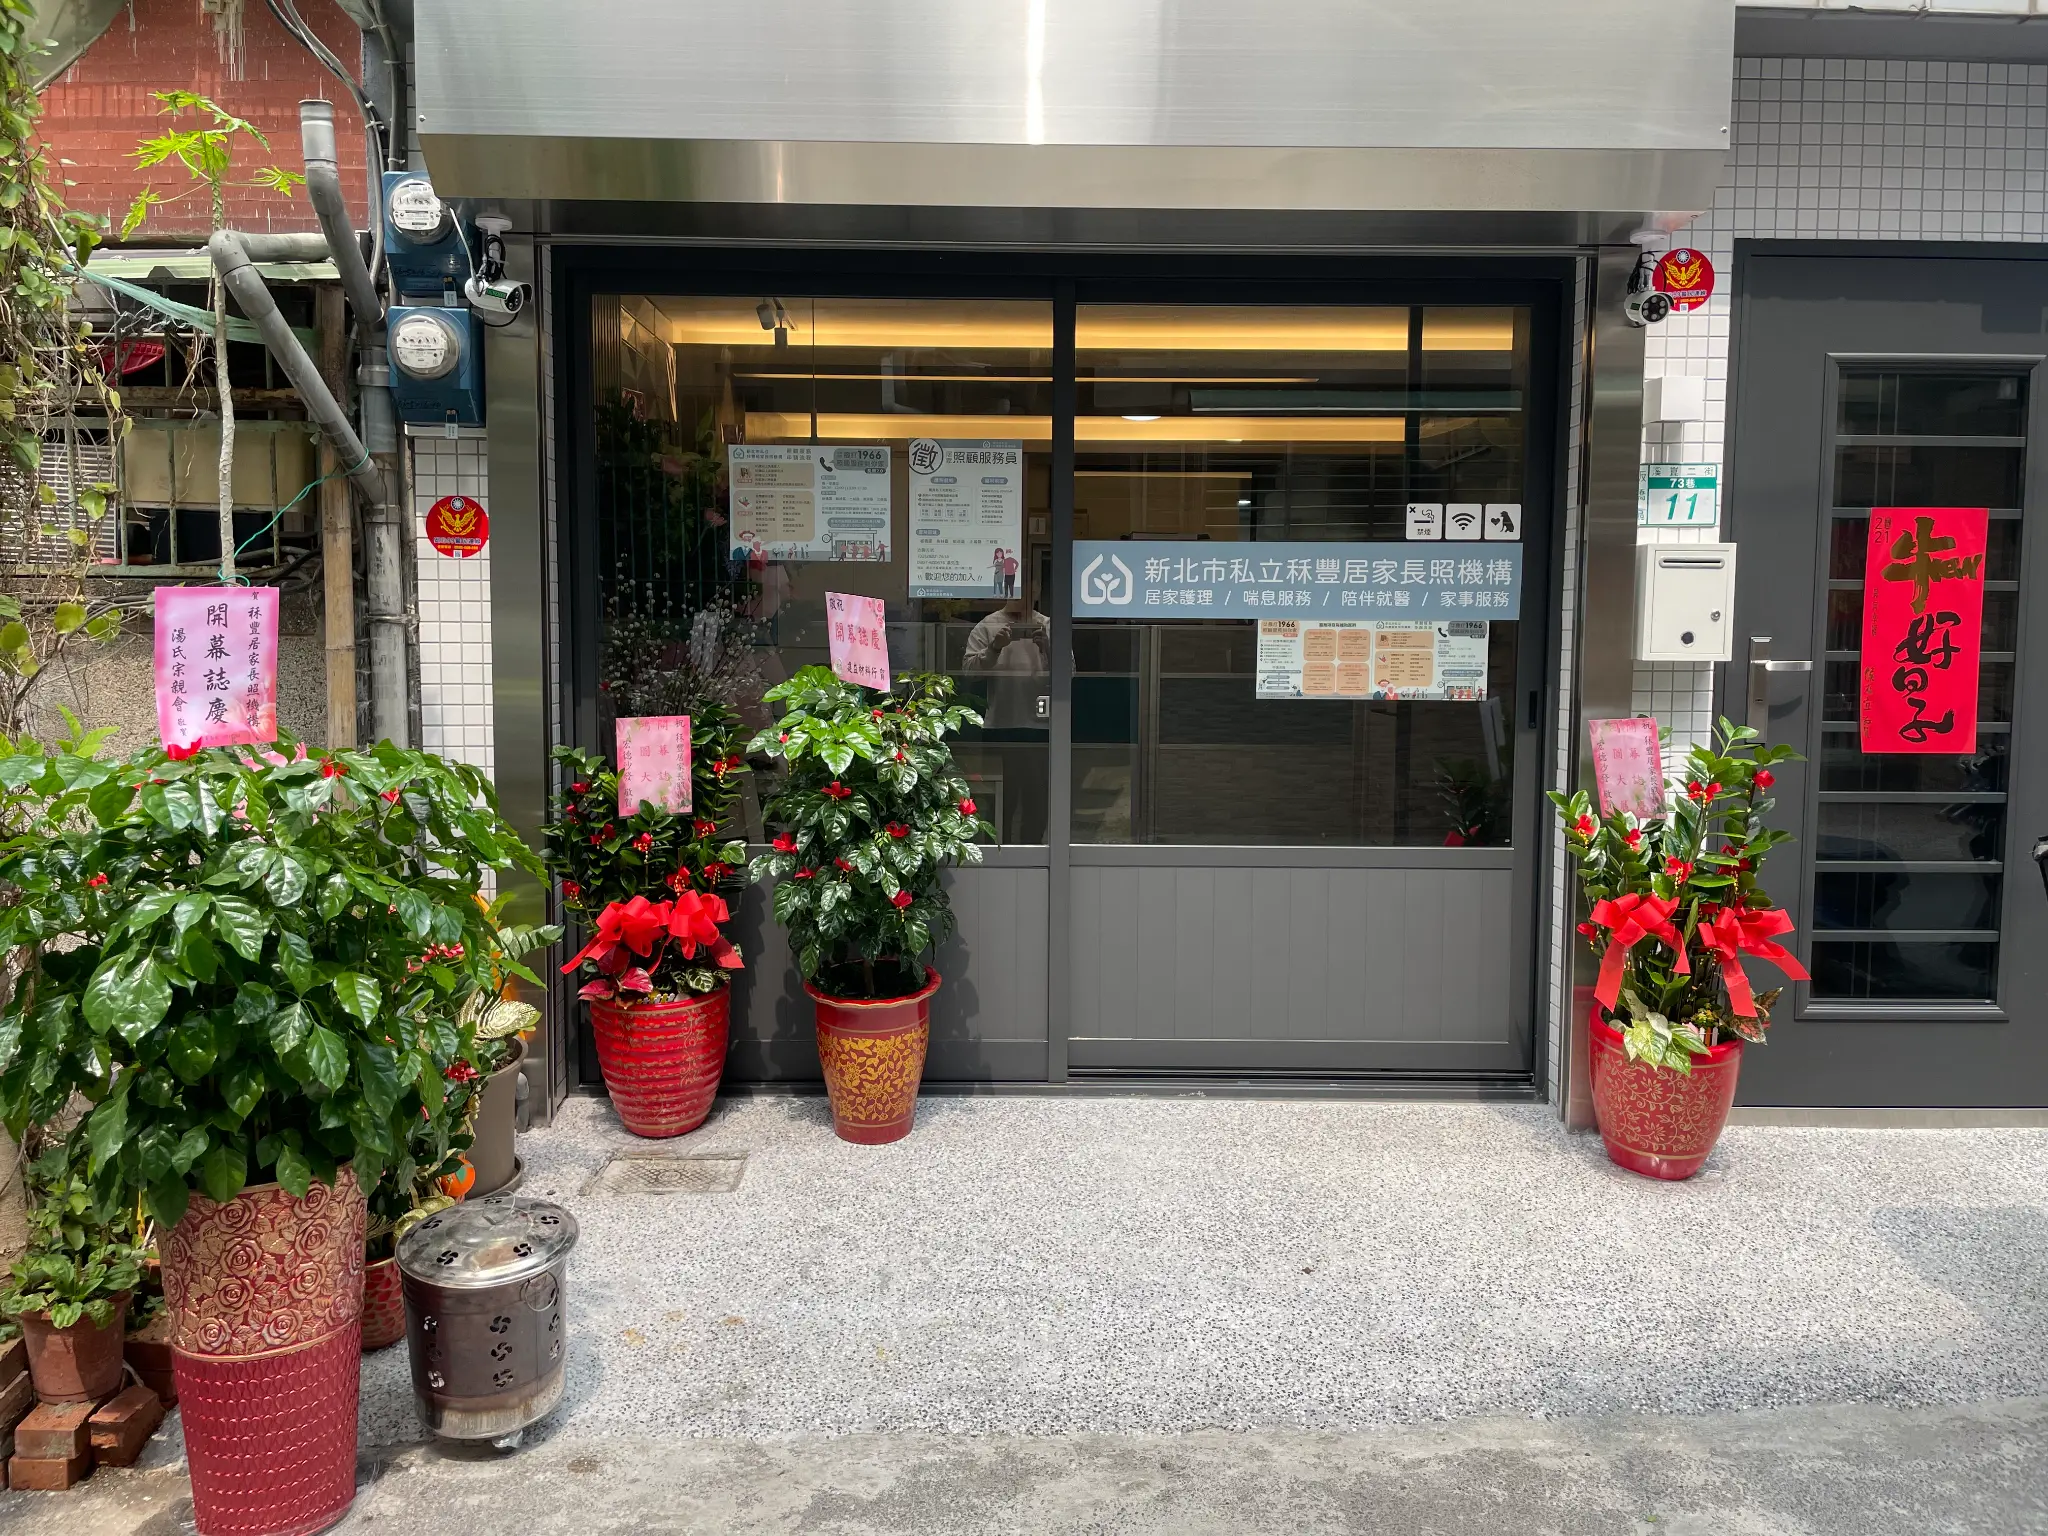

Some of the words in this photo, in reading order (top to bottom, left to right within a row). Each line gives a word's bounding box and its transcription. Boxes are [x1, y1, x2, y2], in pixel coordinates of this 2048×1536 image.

[911, 442, 938, 470] 徵
[953, 451, 1018, 465] 照顧服務員
[1651, 466, 1714, 476] 溪崑二街
[1670, 478, 1696, 488] 73巷
[1666, 493, 1698, 520] 11
[1144, 556, 1513, 586] 新北市私立秝豐居家長照機構
[252, 591, 260, 600] 賀
[1144, 589, 1214, 606] 居家護理
[1243, 590, 1312, 606] 喘息服務
[1341, 590, 1410, 607] 陪伴就醫
[1440, 591, 1510, 607] 家事服務
[171, 628, 188, 712] 湯氏宗親會
[203, 602, 231, 725] 開幕誌慶
[246, 606, 262, 728] 秝豐居家長照機構
